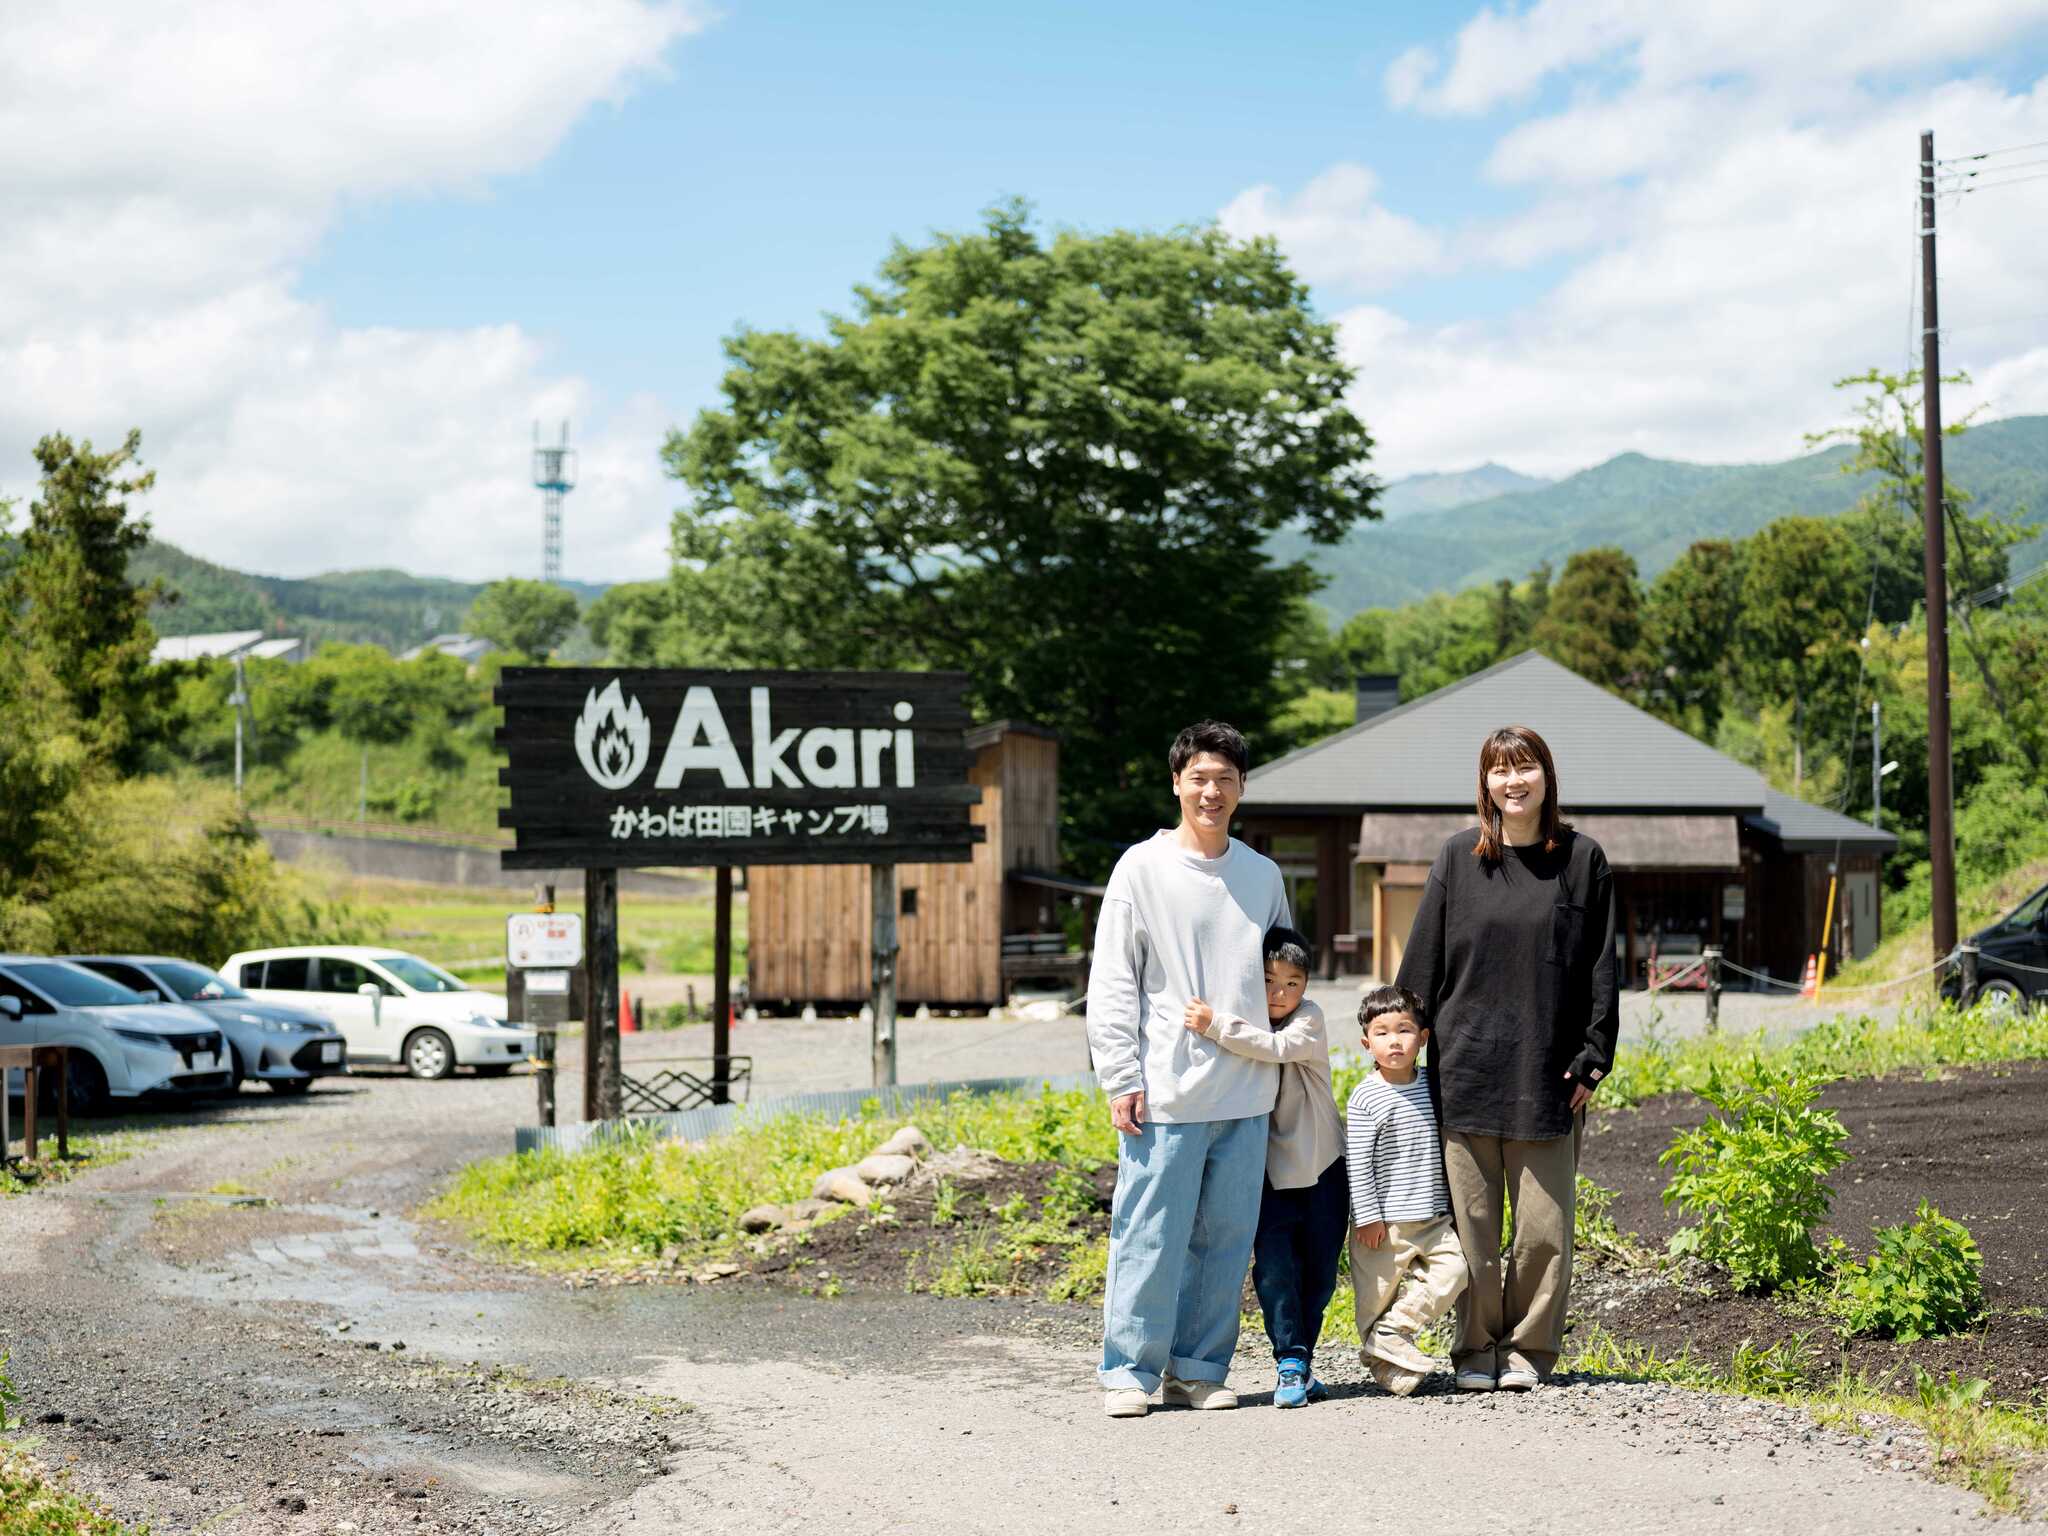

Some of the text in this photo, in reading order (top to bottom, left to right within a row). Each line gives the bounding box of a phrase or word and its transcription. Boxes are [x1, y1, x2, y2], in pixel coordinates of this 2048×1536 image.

[654, 686, 915, 789] Akari
[609, 804, 889, 839] かわば田園キャンプ場
